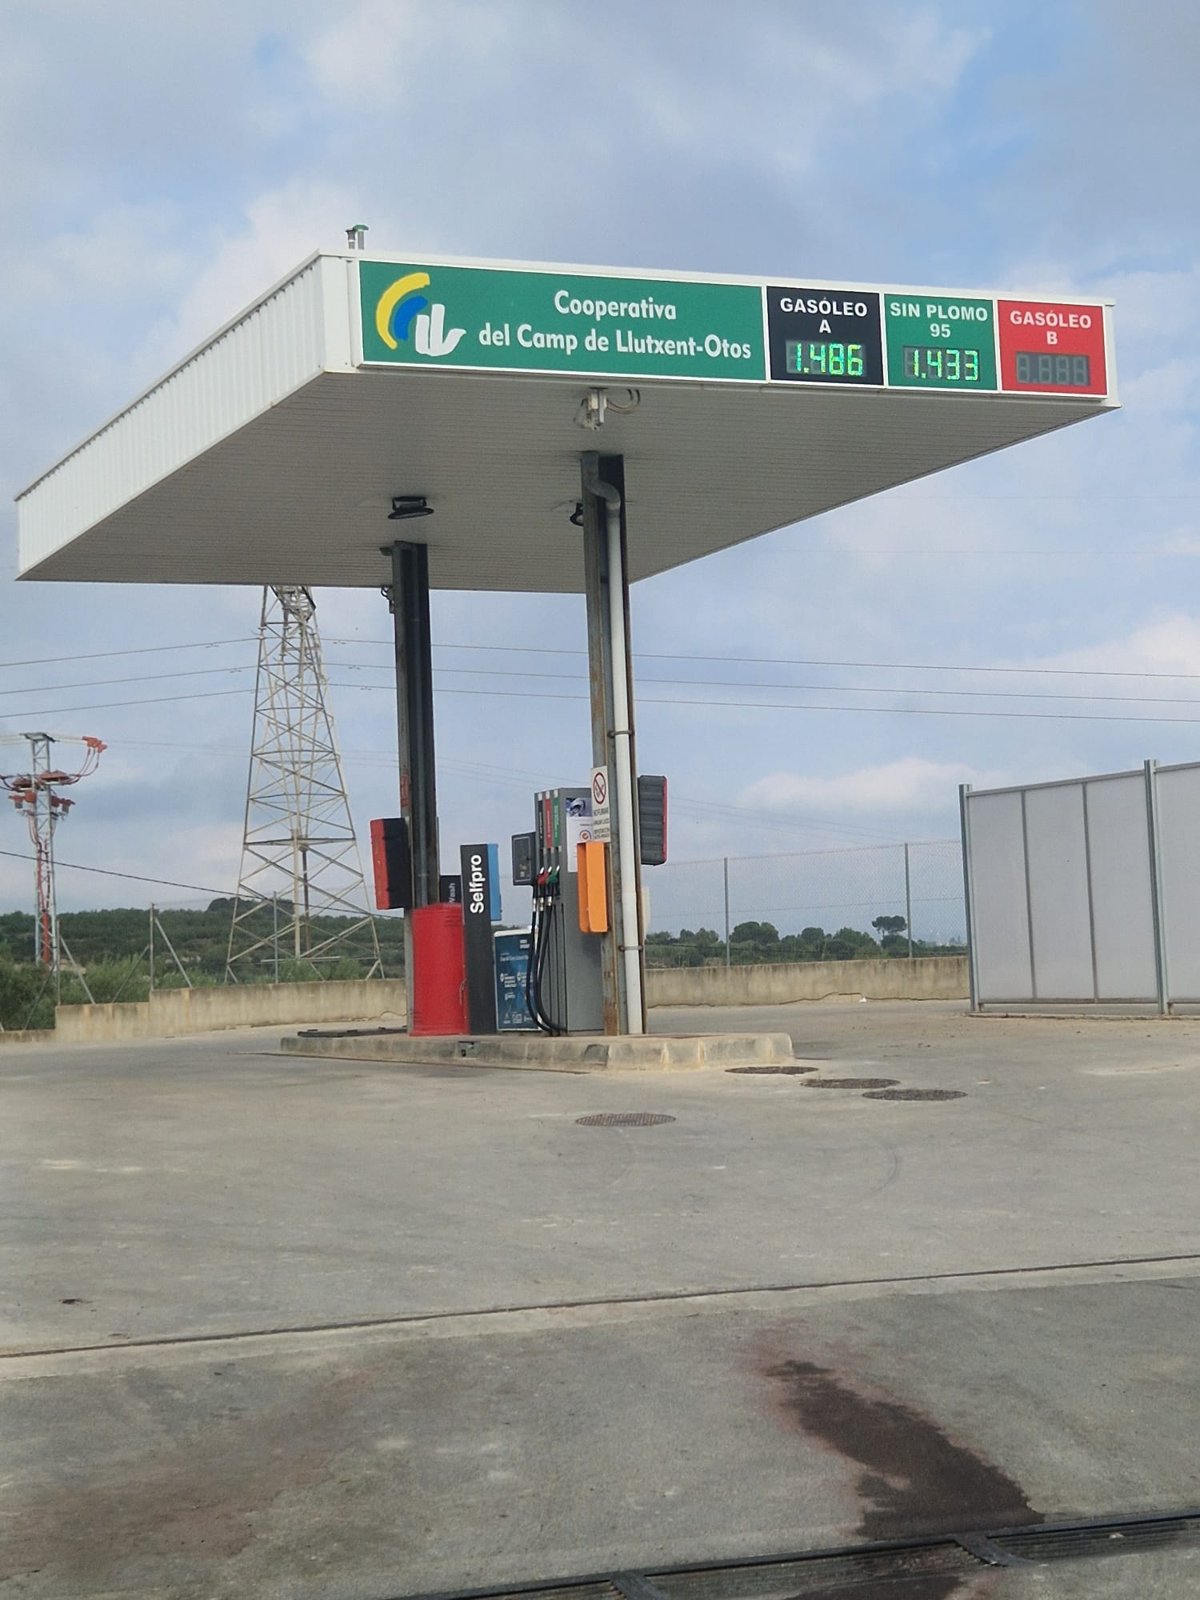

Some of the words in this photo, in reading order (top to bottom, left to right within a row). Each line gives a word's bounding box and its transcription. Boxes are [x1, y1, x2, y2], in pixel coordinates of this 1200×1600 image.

[554, 289, 677, 321] Cooperativa
[780, 297, 868, 317] GASÓLEO
[890, 302, 922, 318] SIN
[926, 304, 988, 322] PLOMO
[819, 319, 831, 334] A
[1010, 309, 1092, 329] GASÓLEO
[930, 323, 951, 338] 95
[1046, 331, 1058, 345] B
[479, 322, 510, 347] del
[517, 324, 578, 356] Camp
[585, 328, 609, 352] de
[616, 329, 752, 360] Llutxent-Otos
[795, 343, 863, 377] 1.486
[912, 349, 979, 381] 1.433
[469, 854, 486, 914] Selfpro
